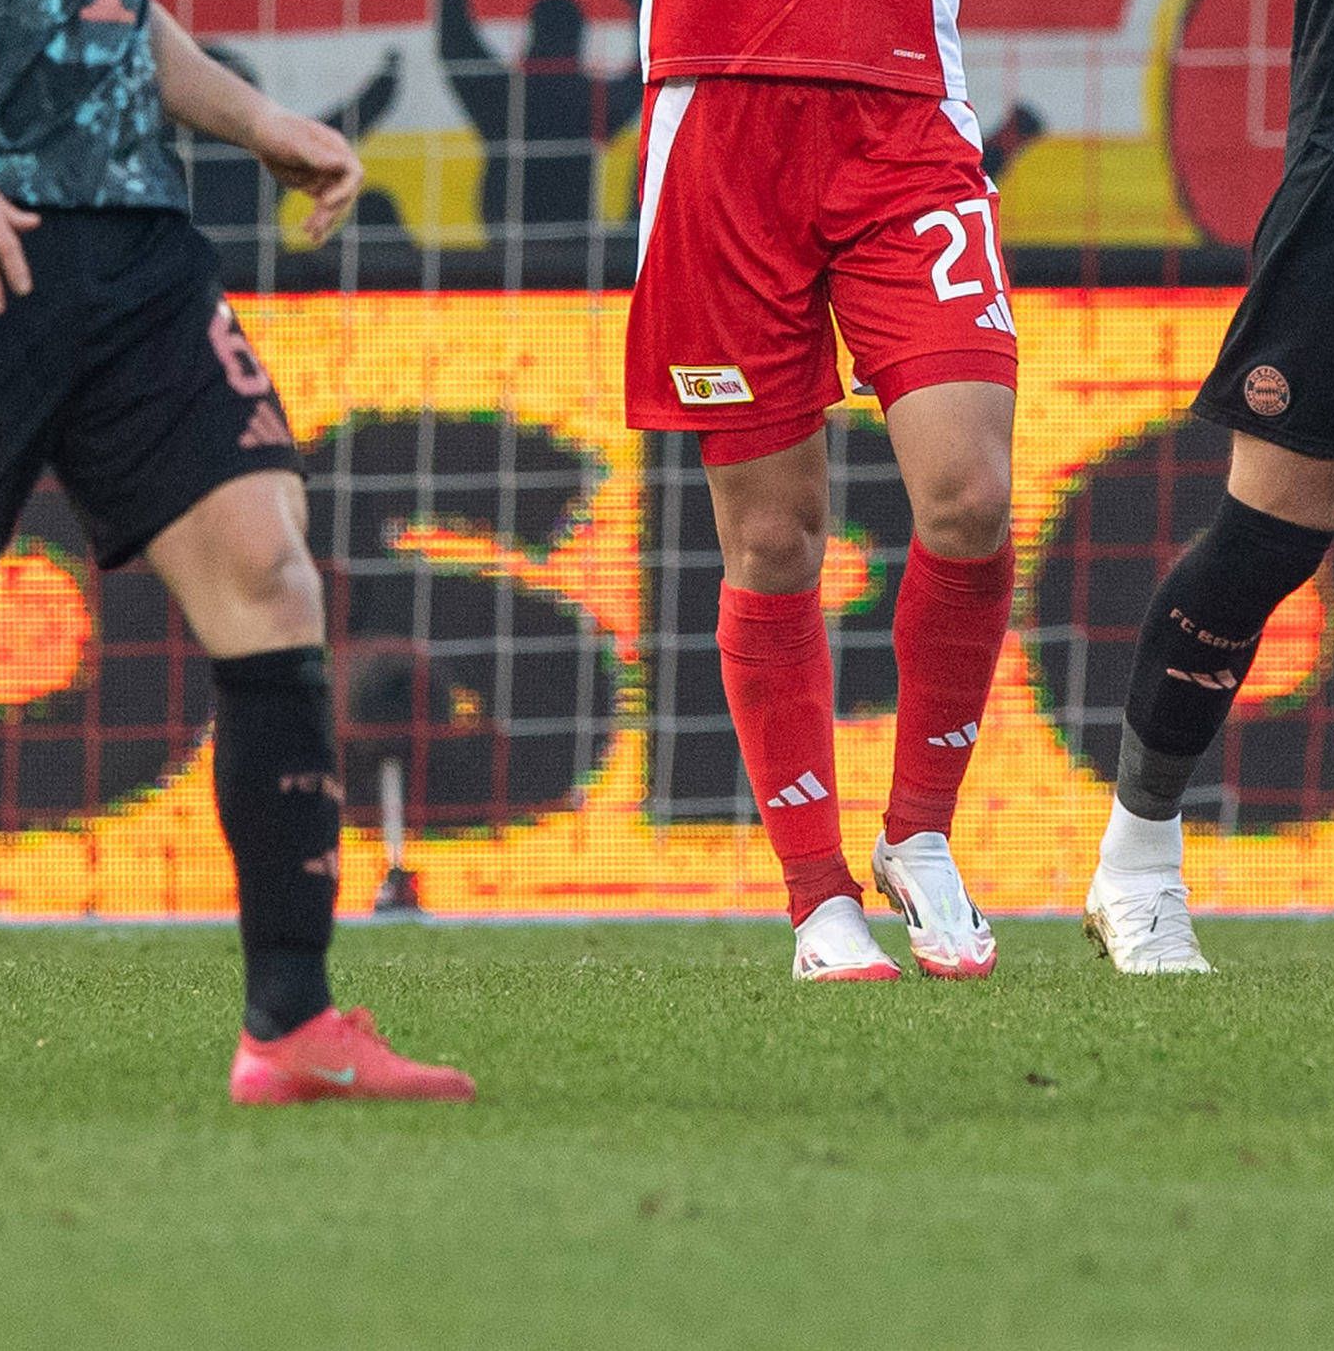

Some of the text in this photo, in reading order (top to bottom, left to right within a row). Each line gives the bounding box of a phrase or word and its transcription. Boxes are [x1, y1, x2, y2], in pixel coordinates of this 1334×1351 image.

[913, 197, 1007, 303] 27
[208, 300, 274, 398] 6
[1169, 608, 1195, 633] FC
